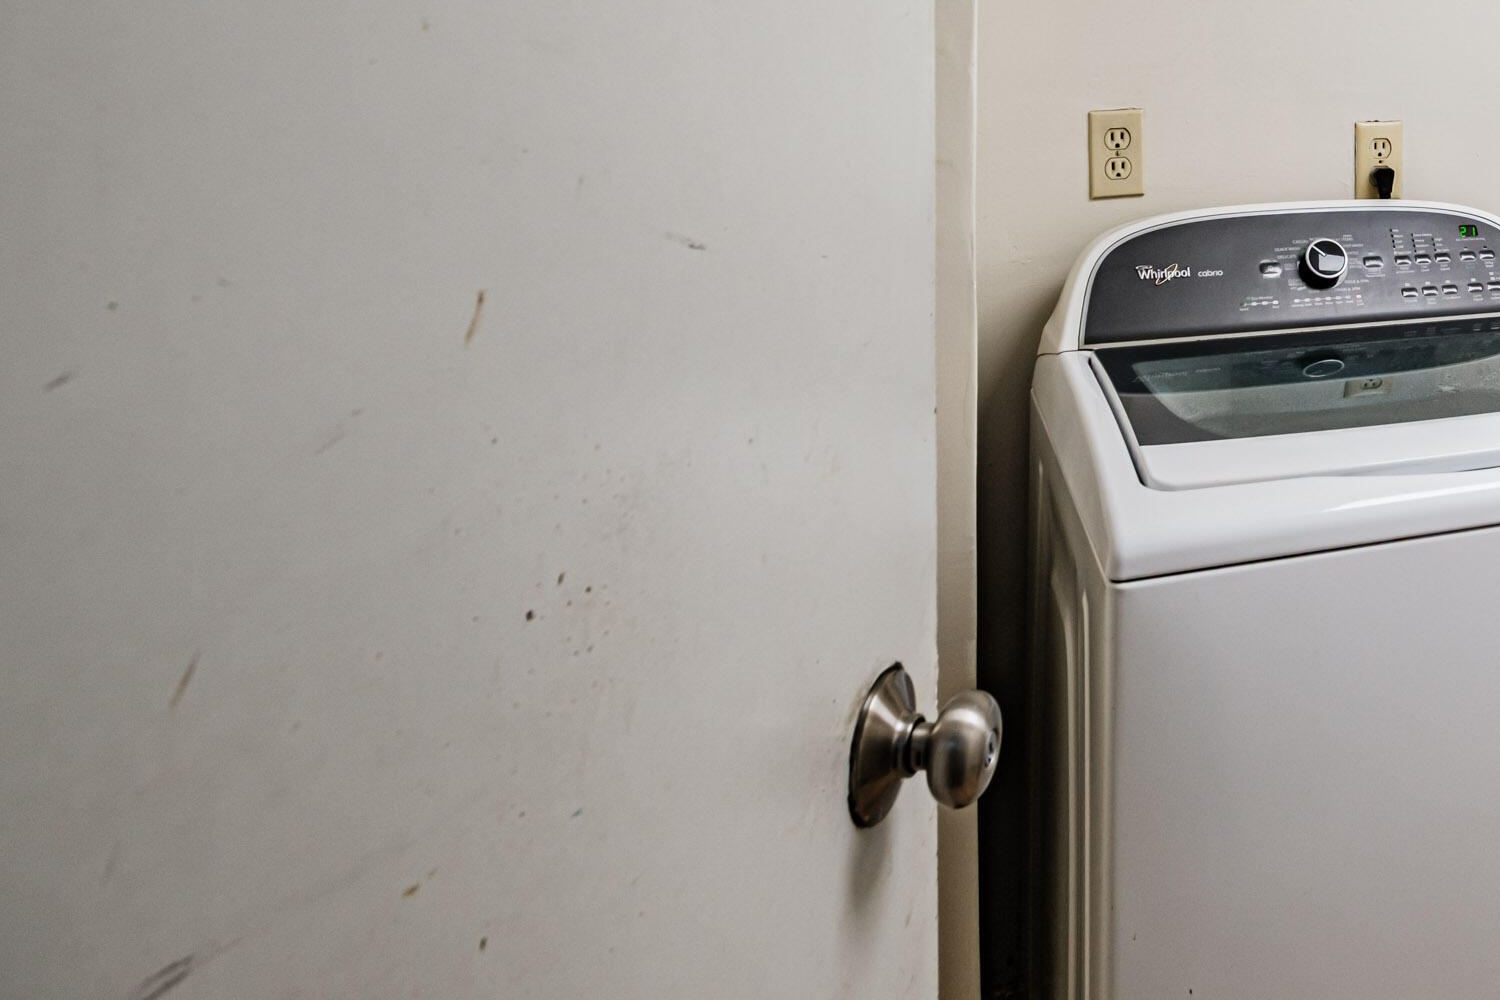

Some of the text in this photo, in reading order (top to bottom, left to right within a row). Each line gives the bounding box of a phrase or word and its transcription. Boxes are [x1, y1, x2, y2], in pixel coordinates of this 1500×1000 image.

[1459, 226, 1475, 238] 21
[1136, 265, 1224, 282] Whirlpool cabrio
